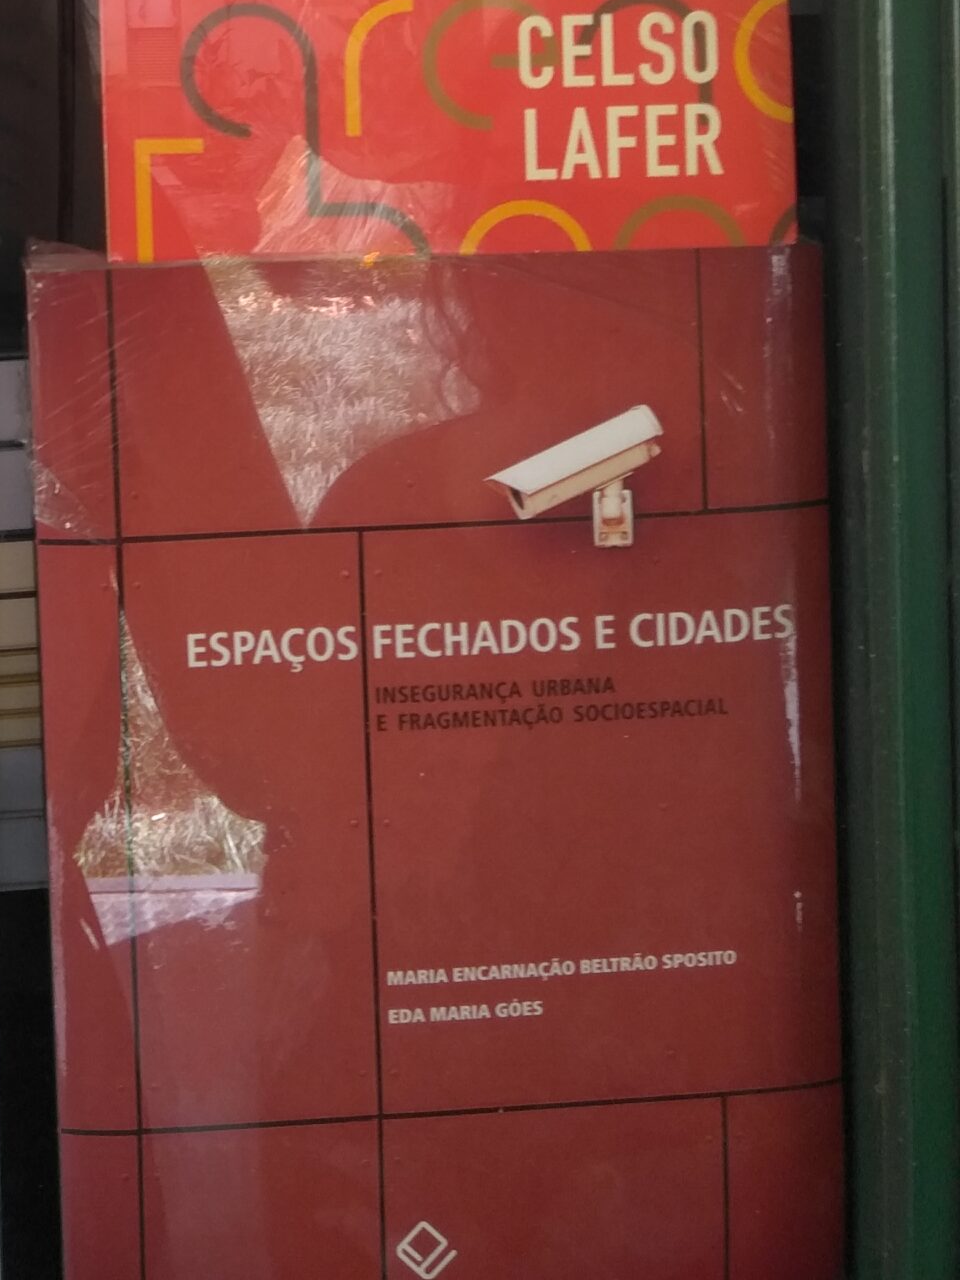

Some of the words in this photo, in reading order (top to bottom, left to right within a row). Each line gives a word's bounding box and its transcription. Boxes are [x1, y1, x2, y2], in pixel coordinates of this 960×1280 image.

[517, 10, 720, 89] CELSO
[523, 103, 725, 182] LAFER
[187, 626, 359, 672] ESPAÇOS
[373, 616, 581, 660] FECHADOS
[595, 615, 616, 650] E
[629, 603, 796, 649] CIDADES
[375, 681, 522, 705] INSEGURANÇA
[531, 676, 615, 698] URBANA
[376, 715, 388, 732] E
[397, 704, 564, 733] FRAGMENTAÇÃO
[573, 699, 729, 722] SOCIOESPACIAL
[387, 969, 448, 986] MARIA
[453, 958, 575, 982] ENCARNAÇÃO
[580, 952, 658, 974] BELTRÃO
[662, 949, 738, 969] SPOSITO
[388, 1007, 425, 1024] EDA
[430, 1003, 490, 1022] MARIA
